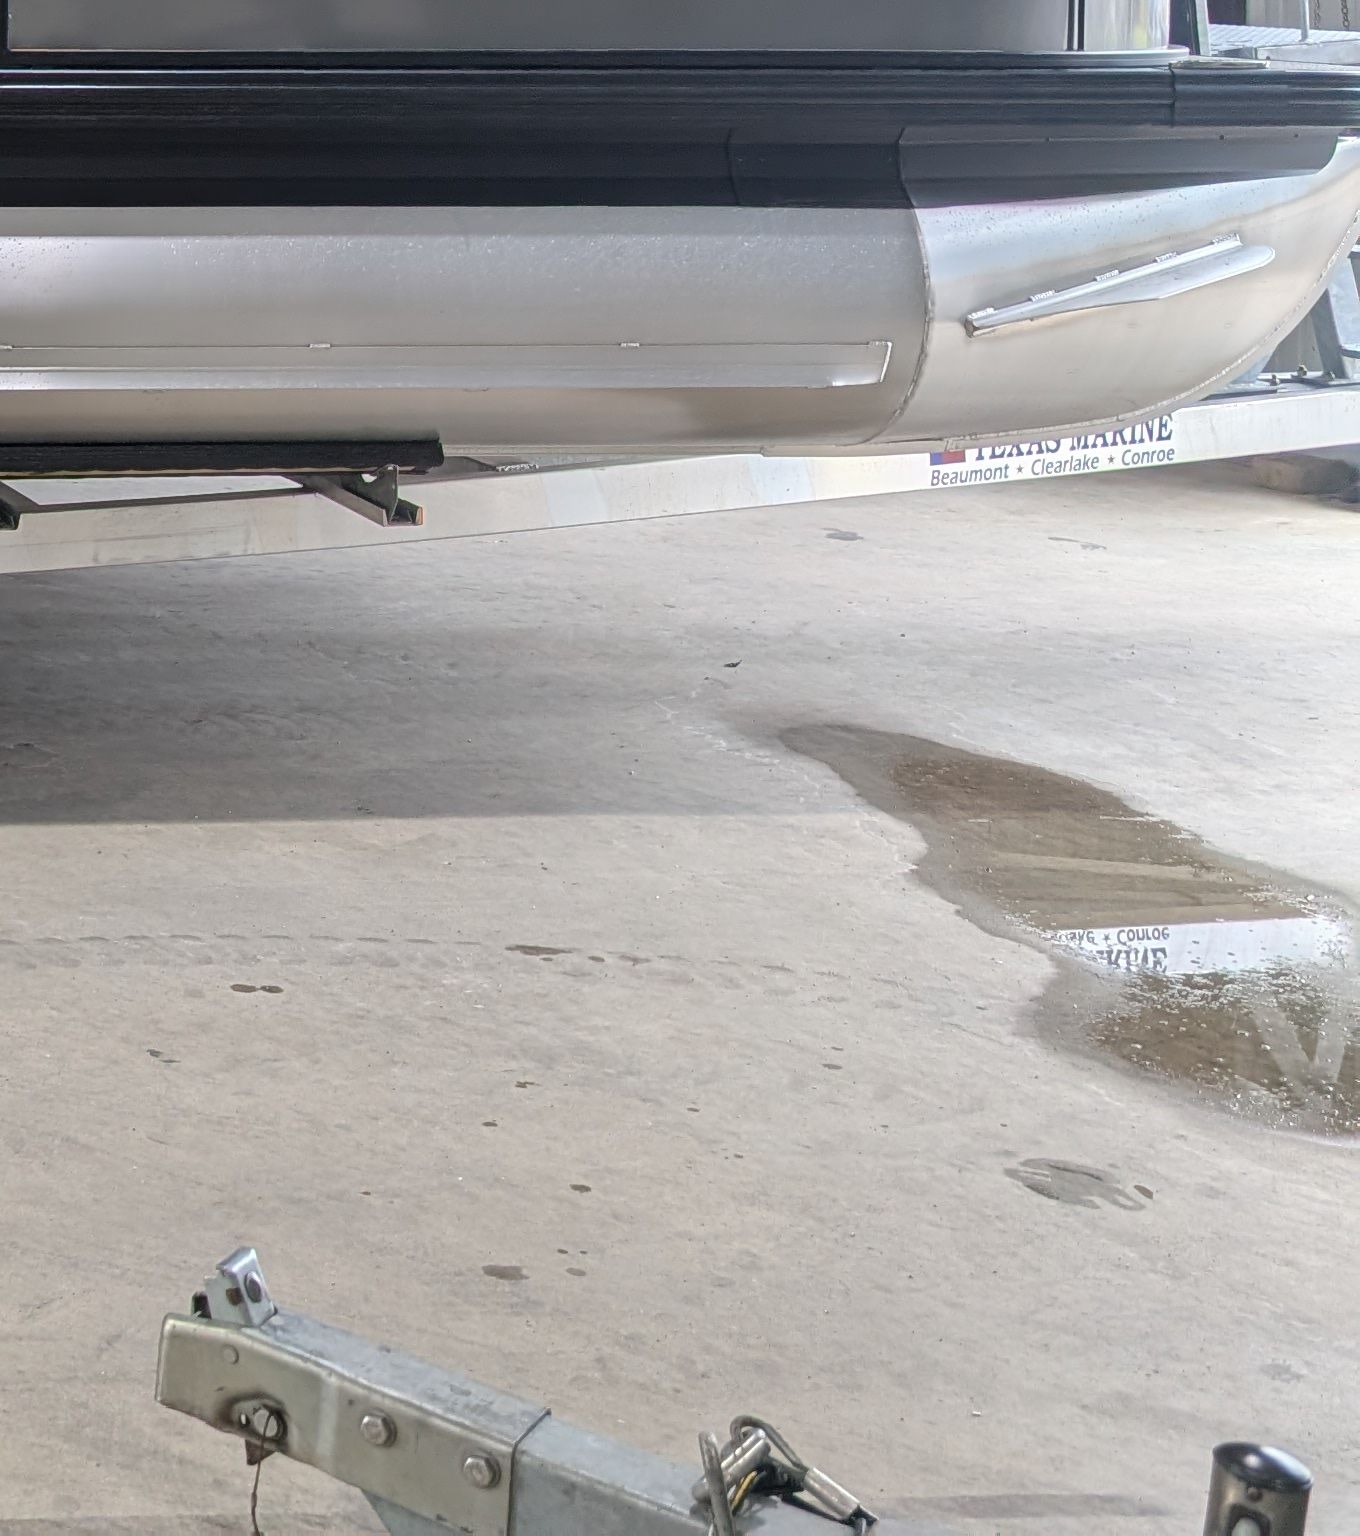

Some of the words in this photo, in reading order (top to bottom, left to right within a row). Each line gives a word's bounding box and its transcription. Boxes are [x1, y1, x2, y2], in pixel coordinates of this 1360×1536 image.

[930, 463, 1010, 487] Beaumont
[1030, 455, 1099, 477] Clearlake
[1121, 448, 1175, 467] Conroe
